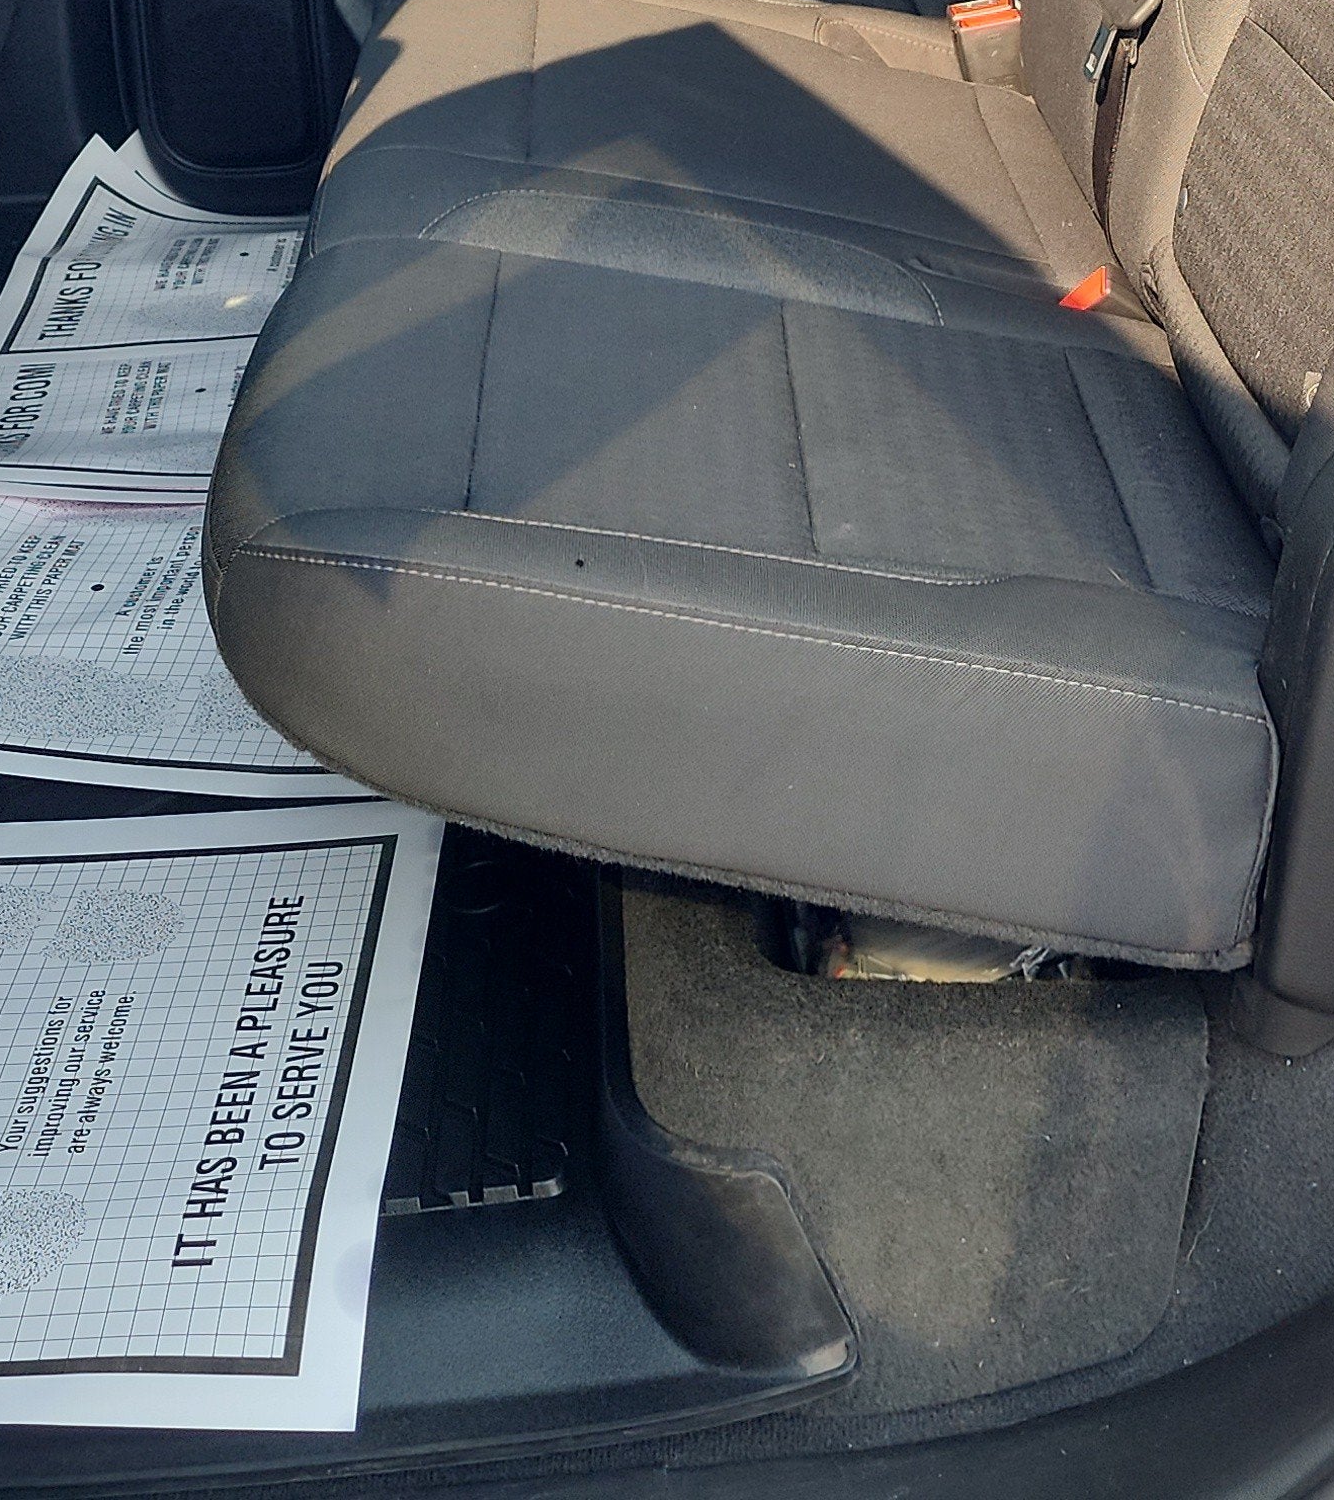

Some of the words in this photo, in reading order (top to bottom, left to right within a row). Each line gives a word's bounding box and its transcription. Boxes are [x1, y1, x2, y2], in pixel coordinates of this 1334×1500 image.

[64, 257, 102, 281] FO
[38, 286, 94, 340] THANKS
[7, 555, 28, 566] TO
[17, 535, 42, 554] KEEP
[147, 556, 164, 567] is
[1, 561, 46, 613] CARPETING
[36, 535, 66, 560] CLEAN
[123, 567, 158, 609] customer
[146, 559, 184, 603] important
[176, 571, 200, 596] world
[8, 614, 38, 641] WITH
[26, 588, 53, 613] THIS
[42, 557, 72, 585] PAPER
[115, 609, 132, 617] A
[135, 604, 160, 632] most
[163, 598, 185, 615] the
[157, 618, 176, 630] in
[122, 636, 145, 655] the
[235, 894, 306, 1034] PLEASURE
[295, 960, 345, 1019] YOU
[74, 989, 107, 1043] service
[98, 990, 138, 1065] welcome.
[17, 1018, 65, 1114] suggestions
[47, 996, 75, 1017] for
[64, 1047, 87, 1074] our
[229, 1039, 269, 1061] A
[271, 1026, 331, 1121] SERVE
[76, 1068, 113, 1124] always
[203, 1069, 261, 1147] BEEN
[27, 1077, 82, 1158] improving
[67, 1128, 92, 1155] are
[258, 1130, 307, 1172] TO
[182, 1155, 239, 1220] HAS
[171, 1233, 218, 1269] IT
